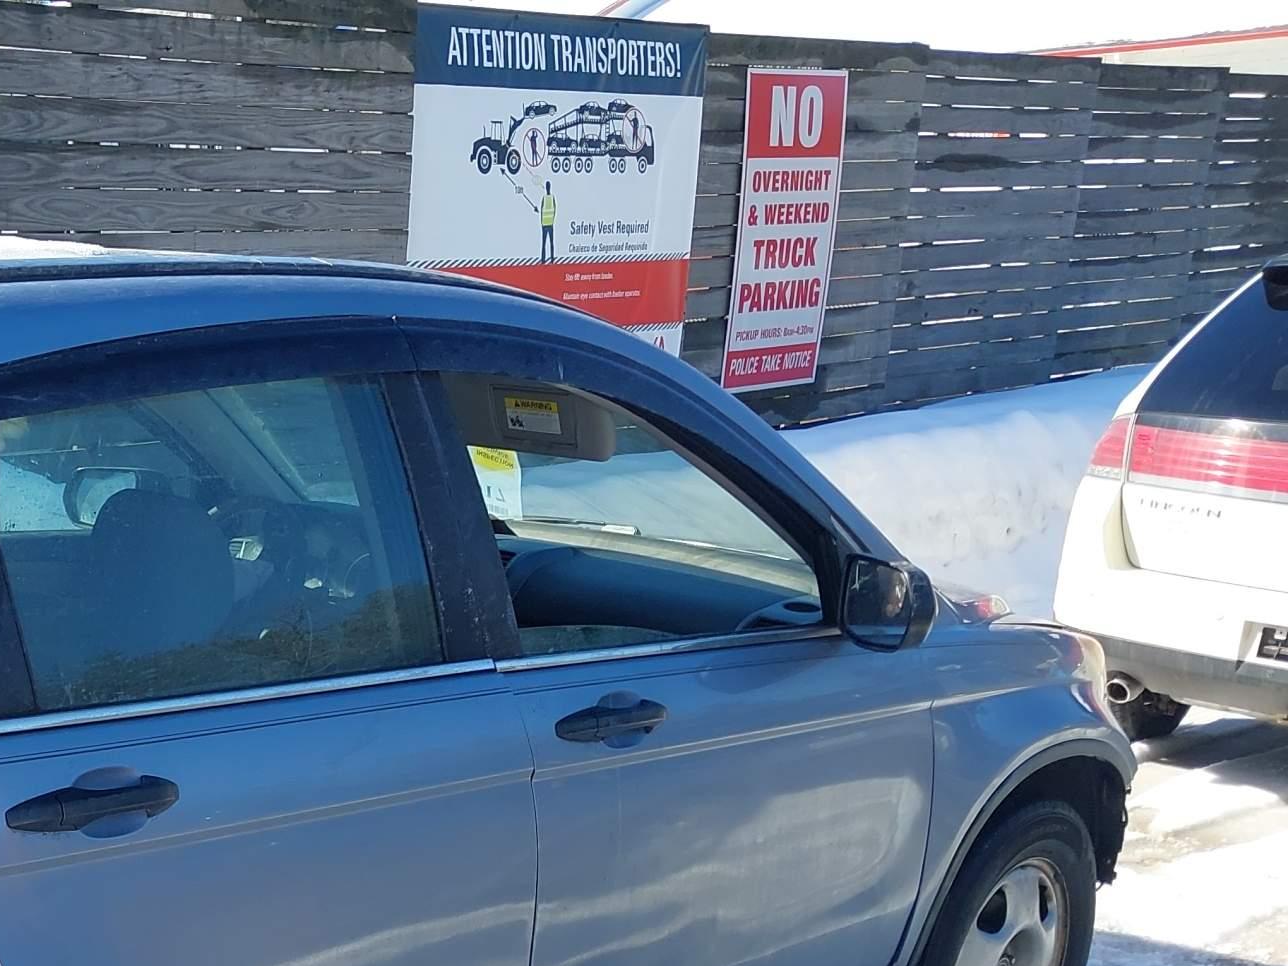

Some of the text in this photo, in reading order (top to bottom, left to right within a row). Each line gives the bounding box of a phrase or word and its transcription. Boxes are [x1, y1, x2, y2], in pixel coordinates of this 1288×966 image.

[447, 26, 681, 78] ATTENTION TRANSPORTERS!
[768, 84, 824, 148] NO
[752, 169, 832, 193] OVERNIGHT
[747, 202, 830, 226] & WEEKEND
[570, 219, 650, 237] Safety Vest Required
[753, 236, 818, 270] TRUCK
[738, 277, 822, 314] PARKING
[736, 329, 760, 342] PICKUP
[760, 327, 782, 339] HOURS:
[728, 350, 813, 377] POLICE TAKE NOTICE
